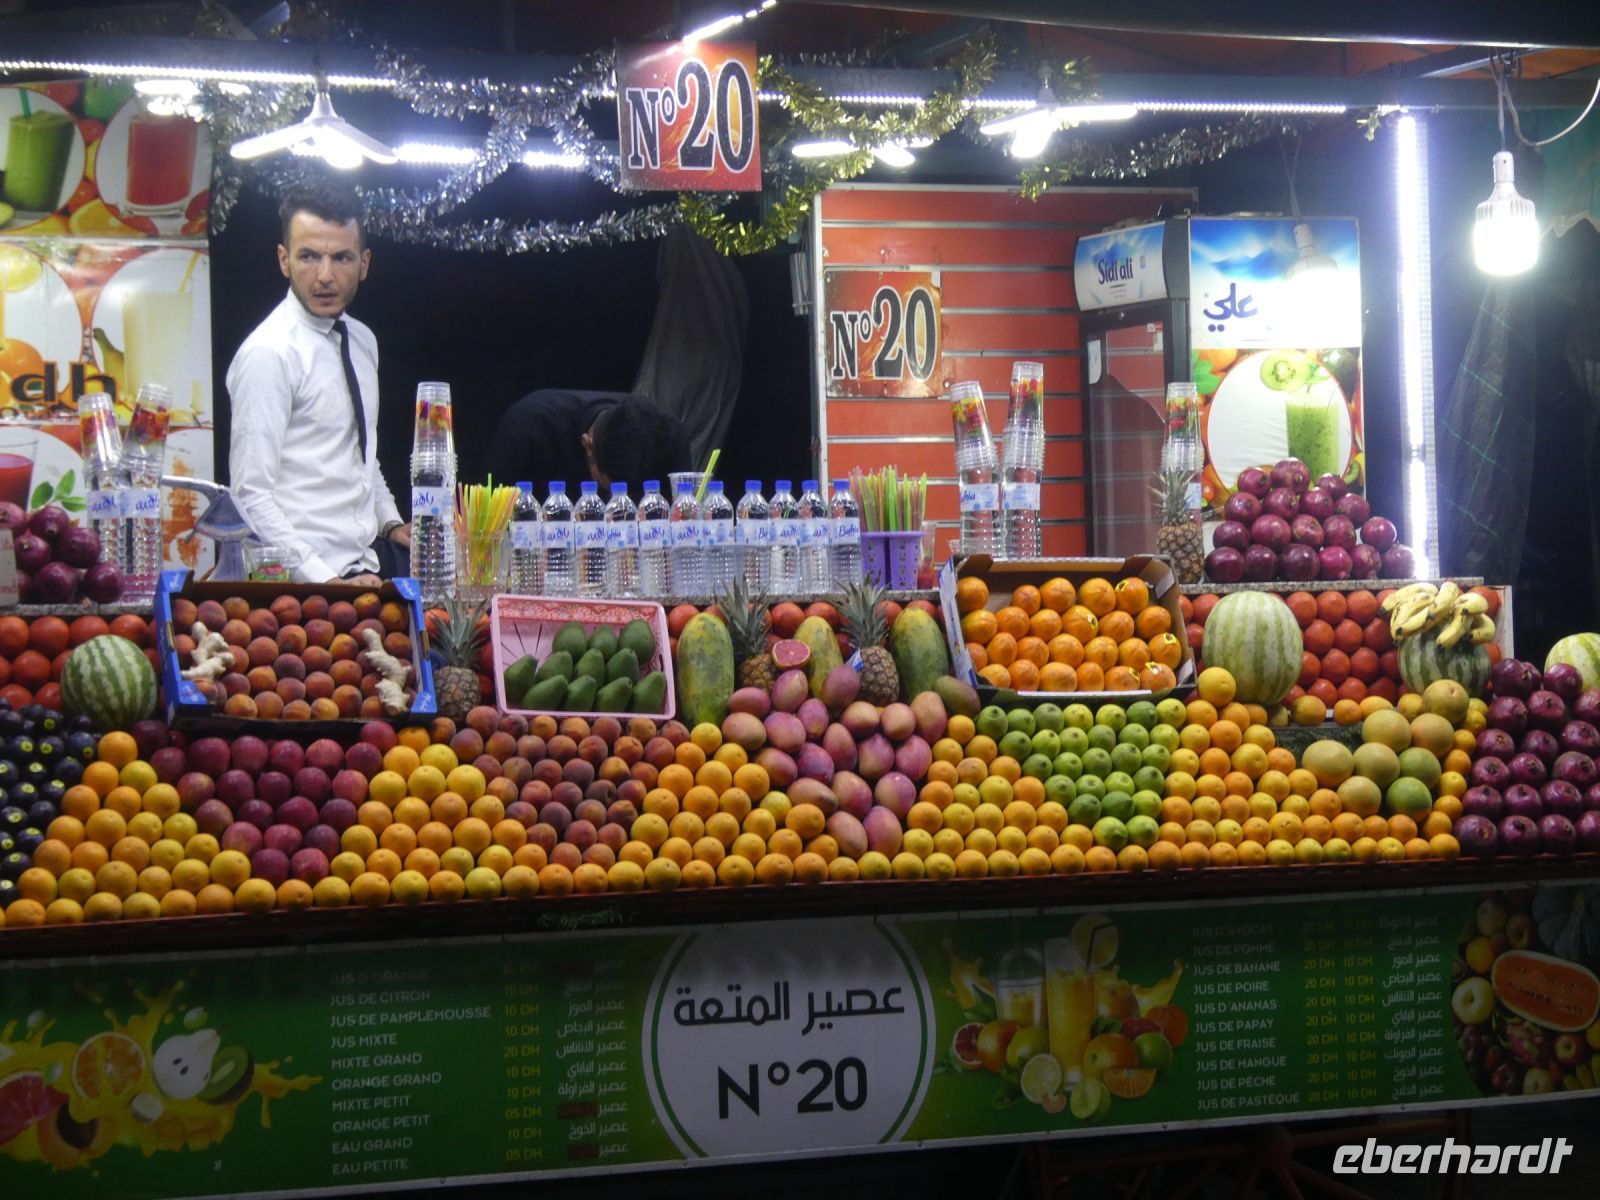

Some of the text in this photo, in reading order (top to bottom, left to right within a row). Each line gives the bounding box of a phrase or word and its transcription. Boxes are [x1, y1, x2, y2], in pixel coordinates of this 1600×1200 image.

[1098, 257, 1133, 285] Sidi ali
[11, 363, 117, 402] dh
[1193, 942, 1275, 957] JUS DE POMME
[1304, 958, 1335, 970] 20 DH
[1344, 956, 1373, 968] 10 DH
[1415, 953, 1441, 968] عصير
[1193, 961, 1280, 976] JUS DE BANANE
[1304, 977, 1336, 990] 20 DH
[1344, 975, 1374, 987] 10 DH
[1416, 972, 1442, 986] عصير
[520, 982, 539, 995] DH
[1194, 980, 1270, 996] JUS DE POIRE
[330, 990, 431, 1007] JUS DE CITRON
[1305, 996, 1337, 1008] 20 DH
[1345, 993, 1375, 1006] 10 DH
[1416, 991, 1442, 1005] عصير
[505, 1003, 539, 1016] 10 DH
[595, 1000, 625, 1016] عصير
[673, 981, 904, 1036] عصير المتعة
[1195, 1003, 1216, 1015] JUS
[331, 1006, 491, 1028] JUS DE PAMPLEMOUSSE
[1306, 1015, 1337, 1027] 20 DH
[1346, 1012, 1375, 1025] 10 DH
[1417, 1010, 1443, 1024] عصير
[506, 1024, 540, 1037] 10 DH
[596, 1020, 626, 1036] عصير
[1195, 1018, 1274, 1034] JUS DE PAPAY
[331, 1033, 398, 1048] JUS MIXTE
[1306, 1033, 1338, 1046] 20 DH
[1346, 1031, 1376, 1043] 10 DH
[1418, 1028, 1443, 1043] عصير
[504, 1044, 540, 1058] 20 DH
[596, 1041, 626, 1057] عصير
[1196, 1037, 1277, 1053] JUS DE FRAISE
[332, 1052, 422, 1070] MIXTE GRAND
[1307, 1052, 1338, 1065] 20 DH
[1347, 1050, 1376, 1062] 10 DH
[1418, 1047, 1444, 1062] عصير
[596, 1061, 627, 1076] عصير
[1196, 1055, 1288, 1073] JUS DE MANGUE
[506, 1065, 541, 1078] 10 DH
[1307, 1071, 1339, 1084] 20 DH
[1347, 1069, 1377, 1081] 10 DH
[1418, 1066, 1444, 1080] عصير
[332, 1072, 442, 1090] ORANGE GRAND
[1197, 1079, 1218, 1091] JUS
[1221, 1078, 1237, 1090] DE
[507, 1085, 541, 1099] 10 DH
[597, 1081, 628, 1097] عصير
[1348, 1087, 1377, 1099] 10 DH
[332, 1095, 411, 1112] MIXTE PETIT
[1198, 1098, 1219, 1110] JUS
[1221, 1097, 1237, 1109] DE
[1308, 1090, 1339, 1103] 20 DH
[505, 1106, 541, 1120] 05 DH
[598, 1102, 628, 1118] عصير
[332, 1114, 431, 1133] ORANGE PETIT
[598, 1122, 629, 1138] عصير
[508, 1127, 542, 1141] 10 DH
[332, 1137, 413, 1155] EAU GRAND
[505, 1147, 543, 1161] 05 DH
[332, 1158, 409, 1175] EAU PETITE
